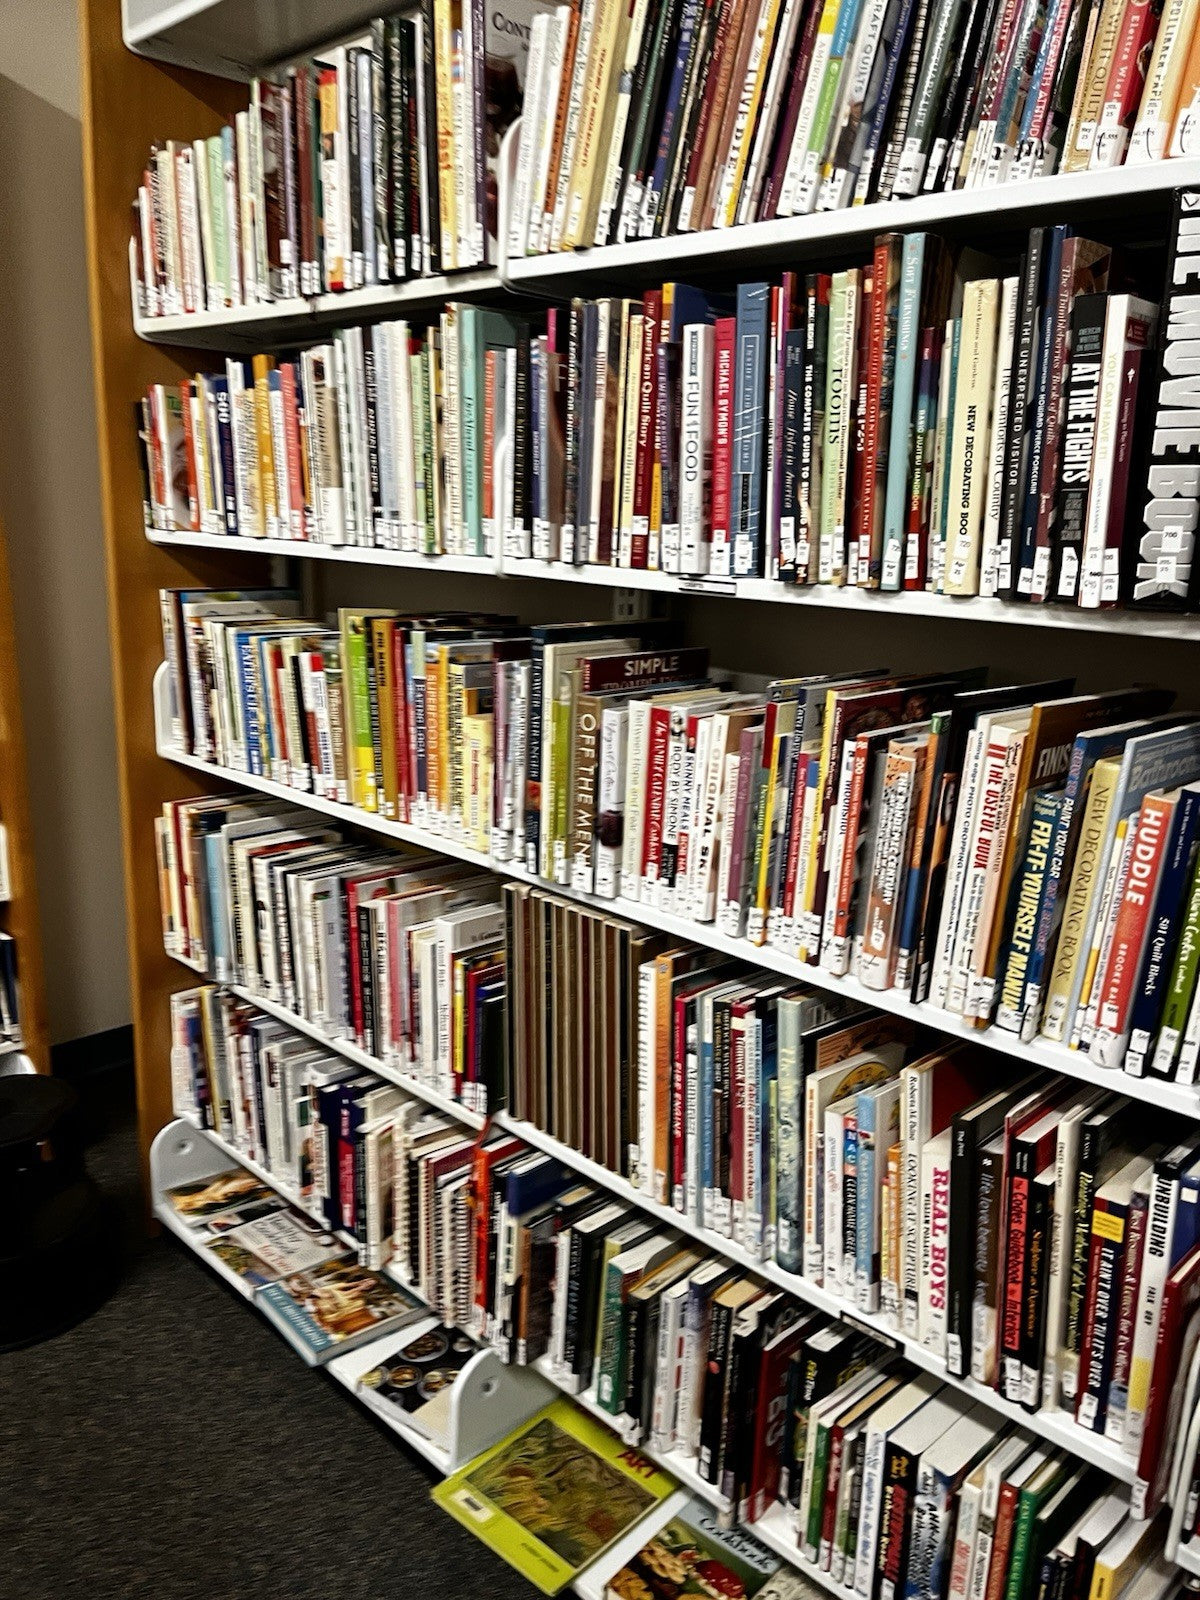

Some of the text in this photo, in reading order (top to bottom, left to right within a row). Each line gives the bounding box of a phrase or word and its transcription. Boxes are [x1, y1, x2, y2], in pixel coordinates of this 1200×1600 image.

[803, 364, 814, 382] THE
[1045, 264, 1072, 446] The Thimbleberries Book of Quilts
[1071, 363, 1101, 382] AT
[637, 317, 657, 447] American Quilt Story
[717, 350, 730, 445] MICHAEL SYMON'S
[1008, 320, 1032, 486] THE UNEXPECTED VISITOR
[1067, 384, 1100, 420] THE
[218, 393, 231, 423] 500
[802, 385, 814, 432] COMPLETE
[684, 382, 700, 482] FUN FOOD
[801, 435, 812, 463] GUIDE
[838, 425, 848, 469] Dimensional
[1029, 394, 1047, 495] HOWARD PIERCE PORCELAIN
[1062, 422, 1096, 485] FIGHTS
[800, 466, 810, 478] TO
[911, 410, 927, 512] BASIC JUJITSU HANDBOOK
[960, 405, 977, 508] NEW DECORATING
[836, 472, 845, 499] Lumber
[862, 456, 874, 531] DECORATING
[1133, 464, 1200, 601] BOOK
[624, 656, 680, 677] SIMPLE
[655, 720, 669, 733] The
[973, 731, 986, 759] cutting
[578, 713, 598, 803] OFF THE
[855, 756, 867, 774] 200
[969, 763, 981, 783] edge
[649, 773, 665, 820] CALENDAR
[668, 745, 683, 840] BODY BY SIMONE
[681, 756, 696, 831] SKINNY MEALS
[702, 747, 720, 837] ORIGINAL
[899, 771, 911, 794] THE
[963, 786, 977, 818] PHOTO
[987, 774, 1005, 795] THE
[888, 795, 908, 854] PANDEMIC
[956, 820, 972, 869] CROPPING
[978, 799, 1003, 844] USEFUL
[1049, 797, 1076, 879] PAINT YOUR CAR
[882, 856, 900, 905] CENTURY
[973, 846, 993, 881] BOOK
[1126, 808, 1165, 906] HUDDLE
[1012, 820, 1054, 952] FIX-IT-YOURSELF
[1054, 786, 1110, 982] NEW DECORATING BOOK
[942, 934, 954, 953] book
[1111, 943, 1129, 984] BROOKE
[1143, 917, 1171, 996] 501 Quilt Blocks
[672, 1061, 684, 1138] FIRE ENGINE
[908, 1076, 919, 1107] Roberta
[744, 1082, 759, 1200] fabric artists workshop
[955, 1130, 966, 1157] The Print
[904, 1153, 920, 1290] LOOKING AT SCULPTURE
[923, 1193, 932, 1225] WILLIAM
[926, 1167, 951, 1310] REAL BOYS
[1101, 1247, 1115, 1256] IT
[1004, 1192, 1027, 1347] Codes Guidebook Interiors
[1099, 1259, 1114, 1288] AIN'T
[1118, 1210, 1145, 1333] Best Resumes & Letters for
[1095, 1290, 1110, 1319] OVER
[1092, 1338, 1107, 1358] IT'S
[1088, 1360, 1103, 1388] OVER
[617, 1450, 659, 1480] ART
[881, 1485, 895, 1533] Bathroom
